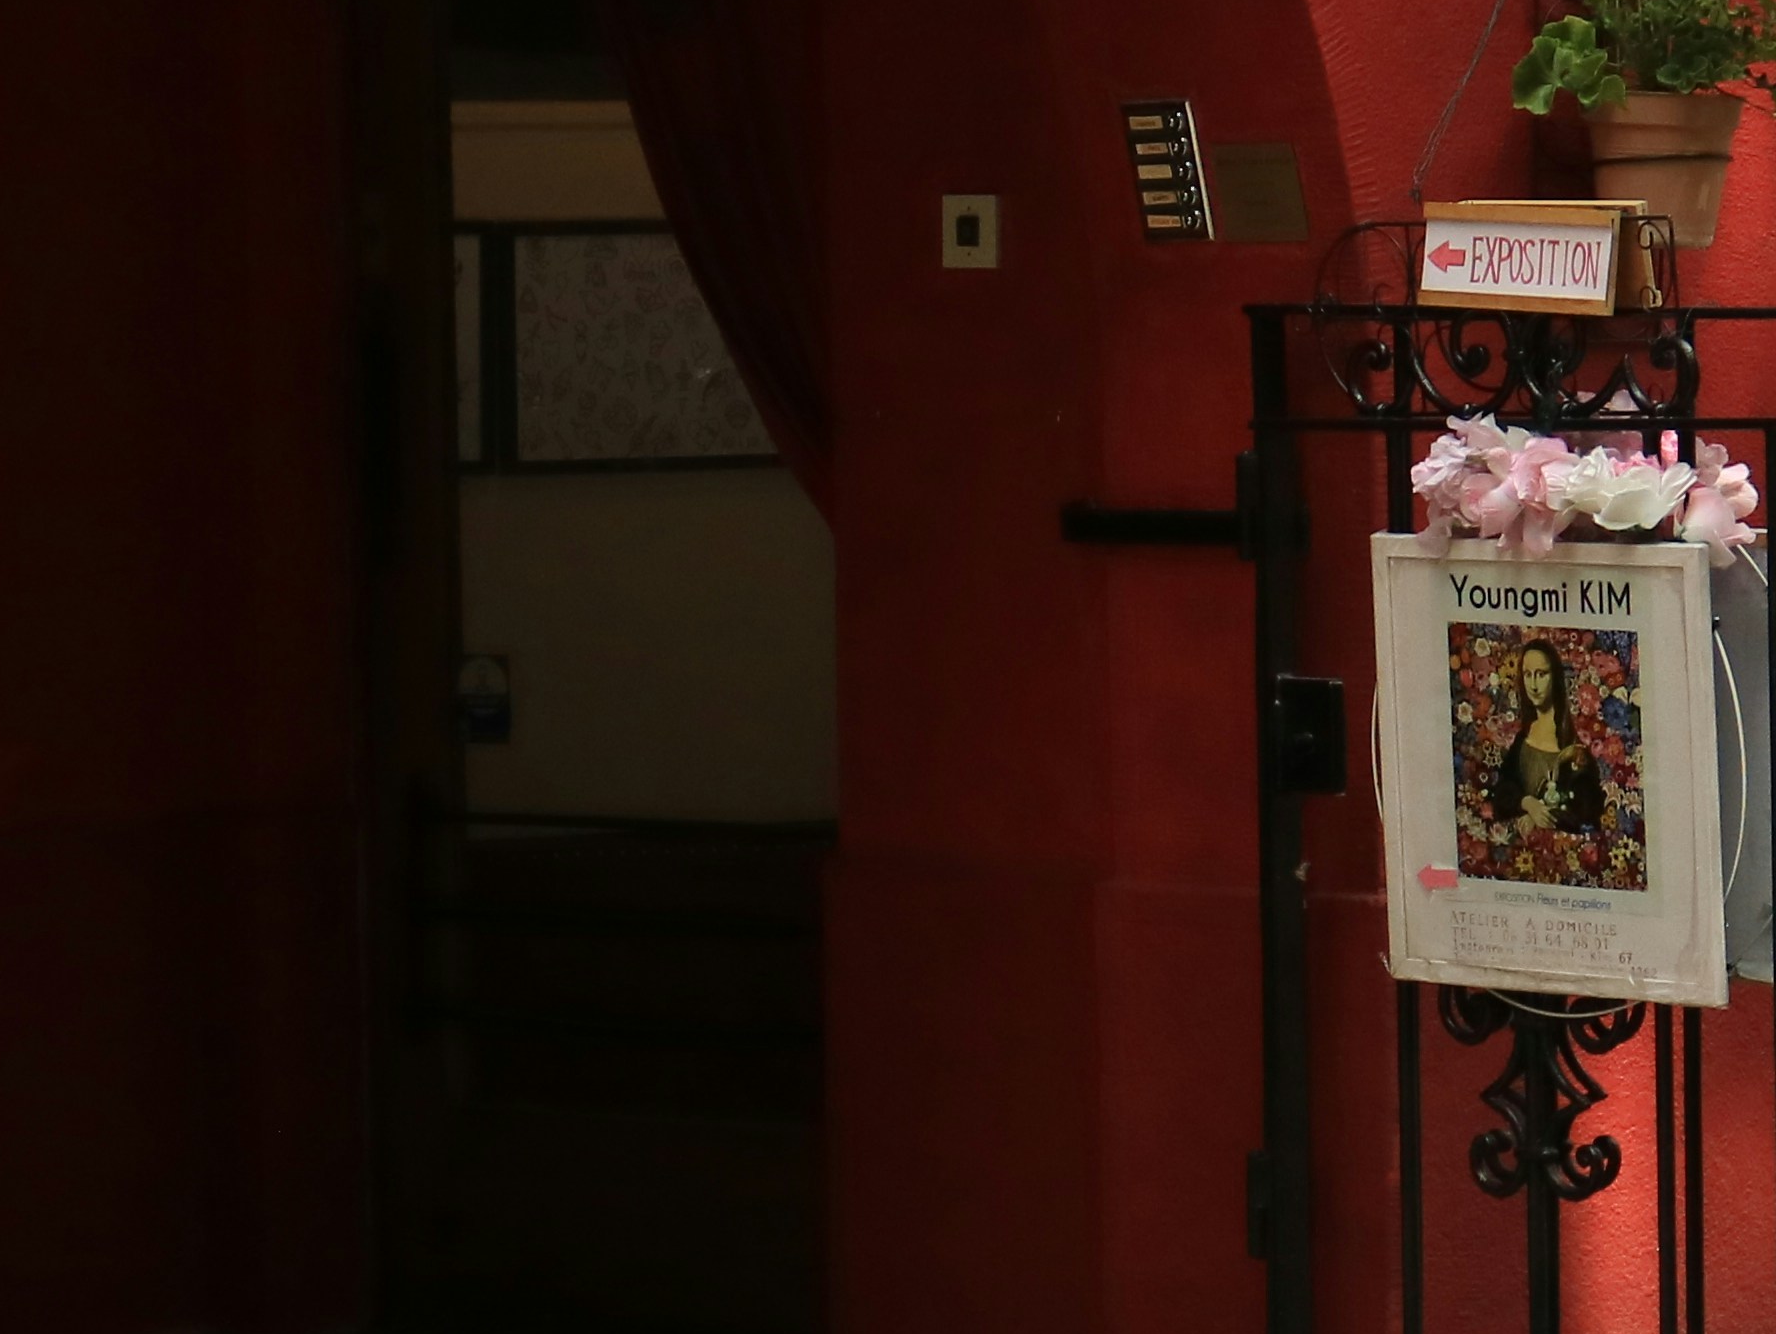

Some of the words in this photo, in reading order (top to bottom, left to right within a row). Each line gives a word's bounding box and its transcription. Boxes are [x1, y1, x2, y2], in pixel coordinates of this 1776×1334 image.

[1470, 235, 1602, 289] EXPOSITION
[1449, 573, 1567, 617] Youngmi
[1580, 579, 1631, 616] KIM
[1545, 919, 1617, 937] DOMICILE
